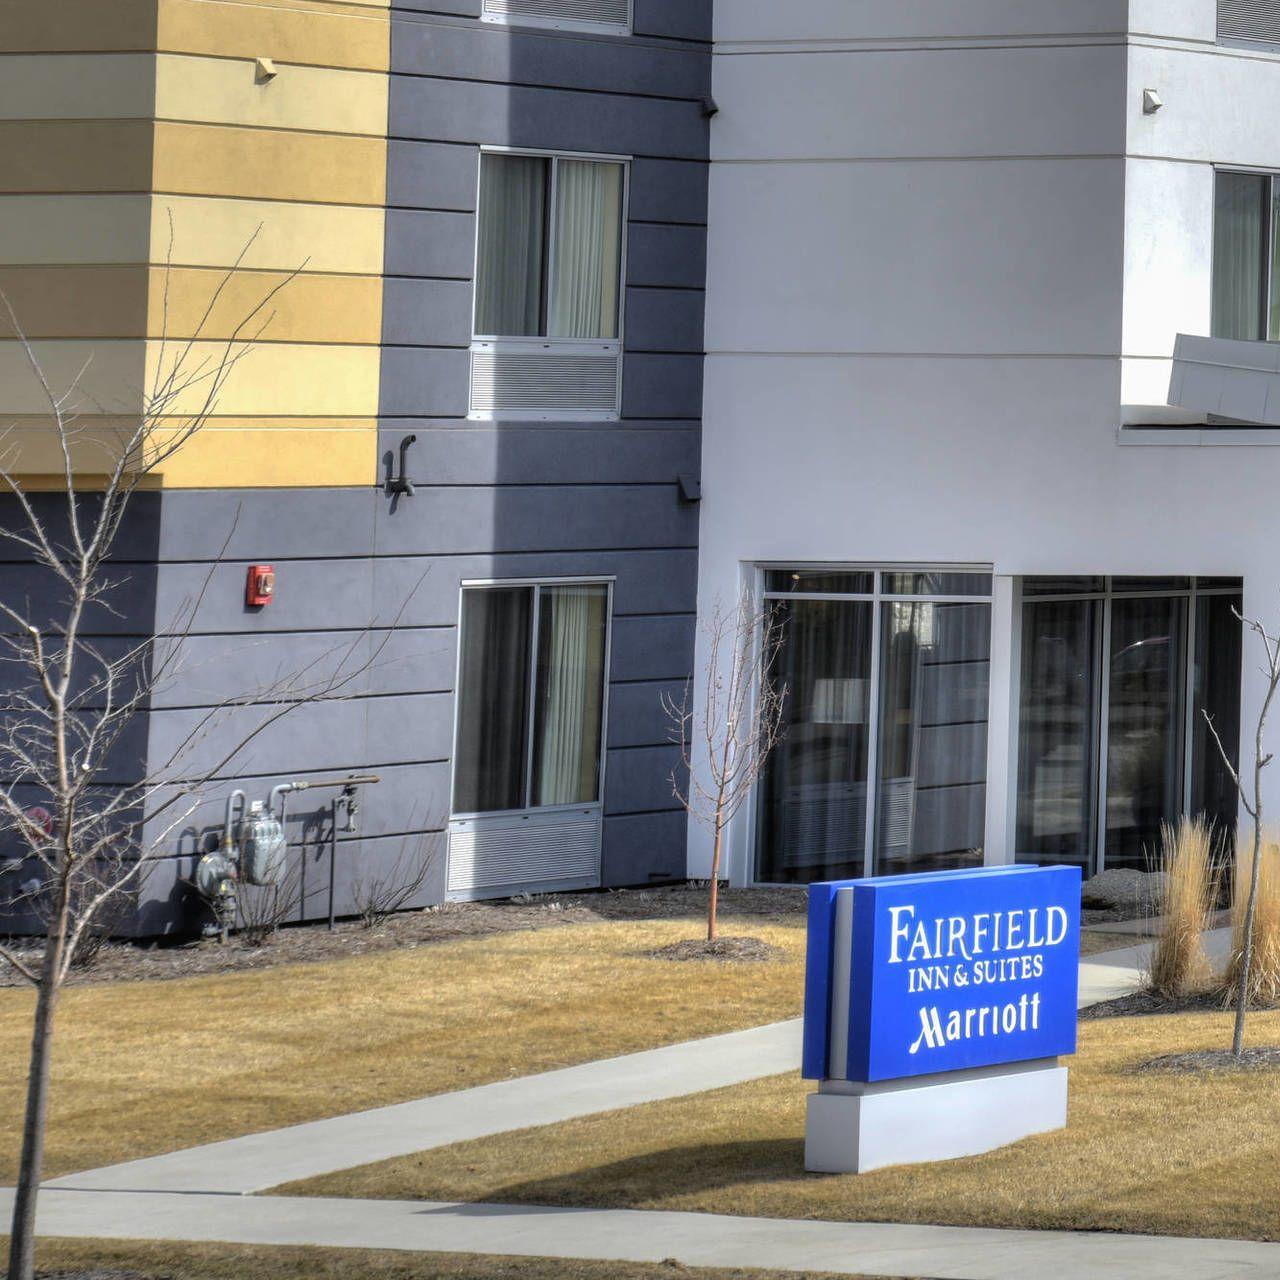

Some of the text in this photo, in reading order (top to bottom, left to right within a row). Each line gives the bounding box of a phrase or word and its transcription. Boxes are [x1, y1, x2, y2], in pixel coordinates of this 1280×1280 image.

[888, 904, 1068, 964] FAIRFIELD
[908, 953, 1044, 993] INN & SUITES
[908, 992, 1041, 1055] Marriott
